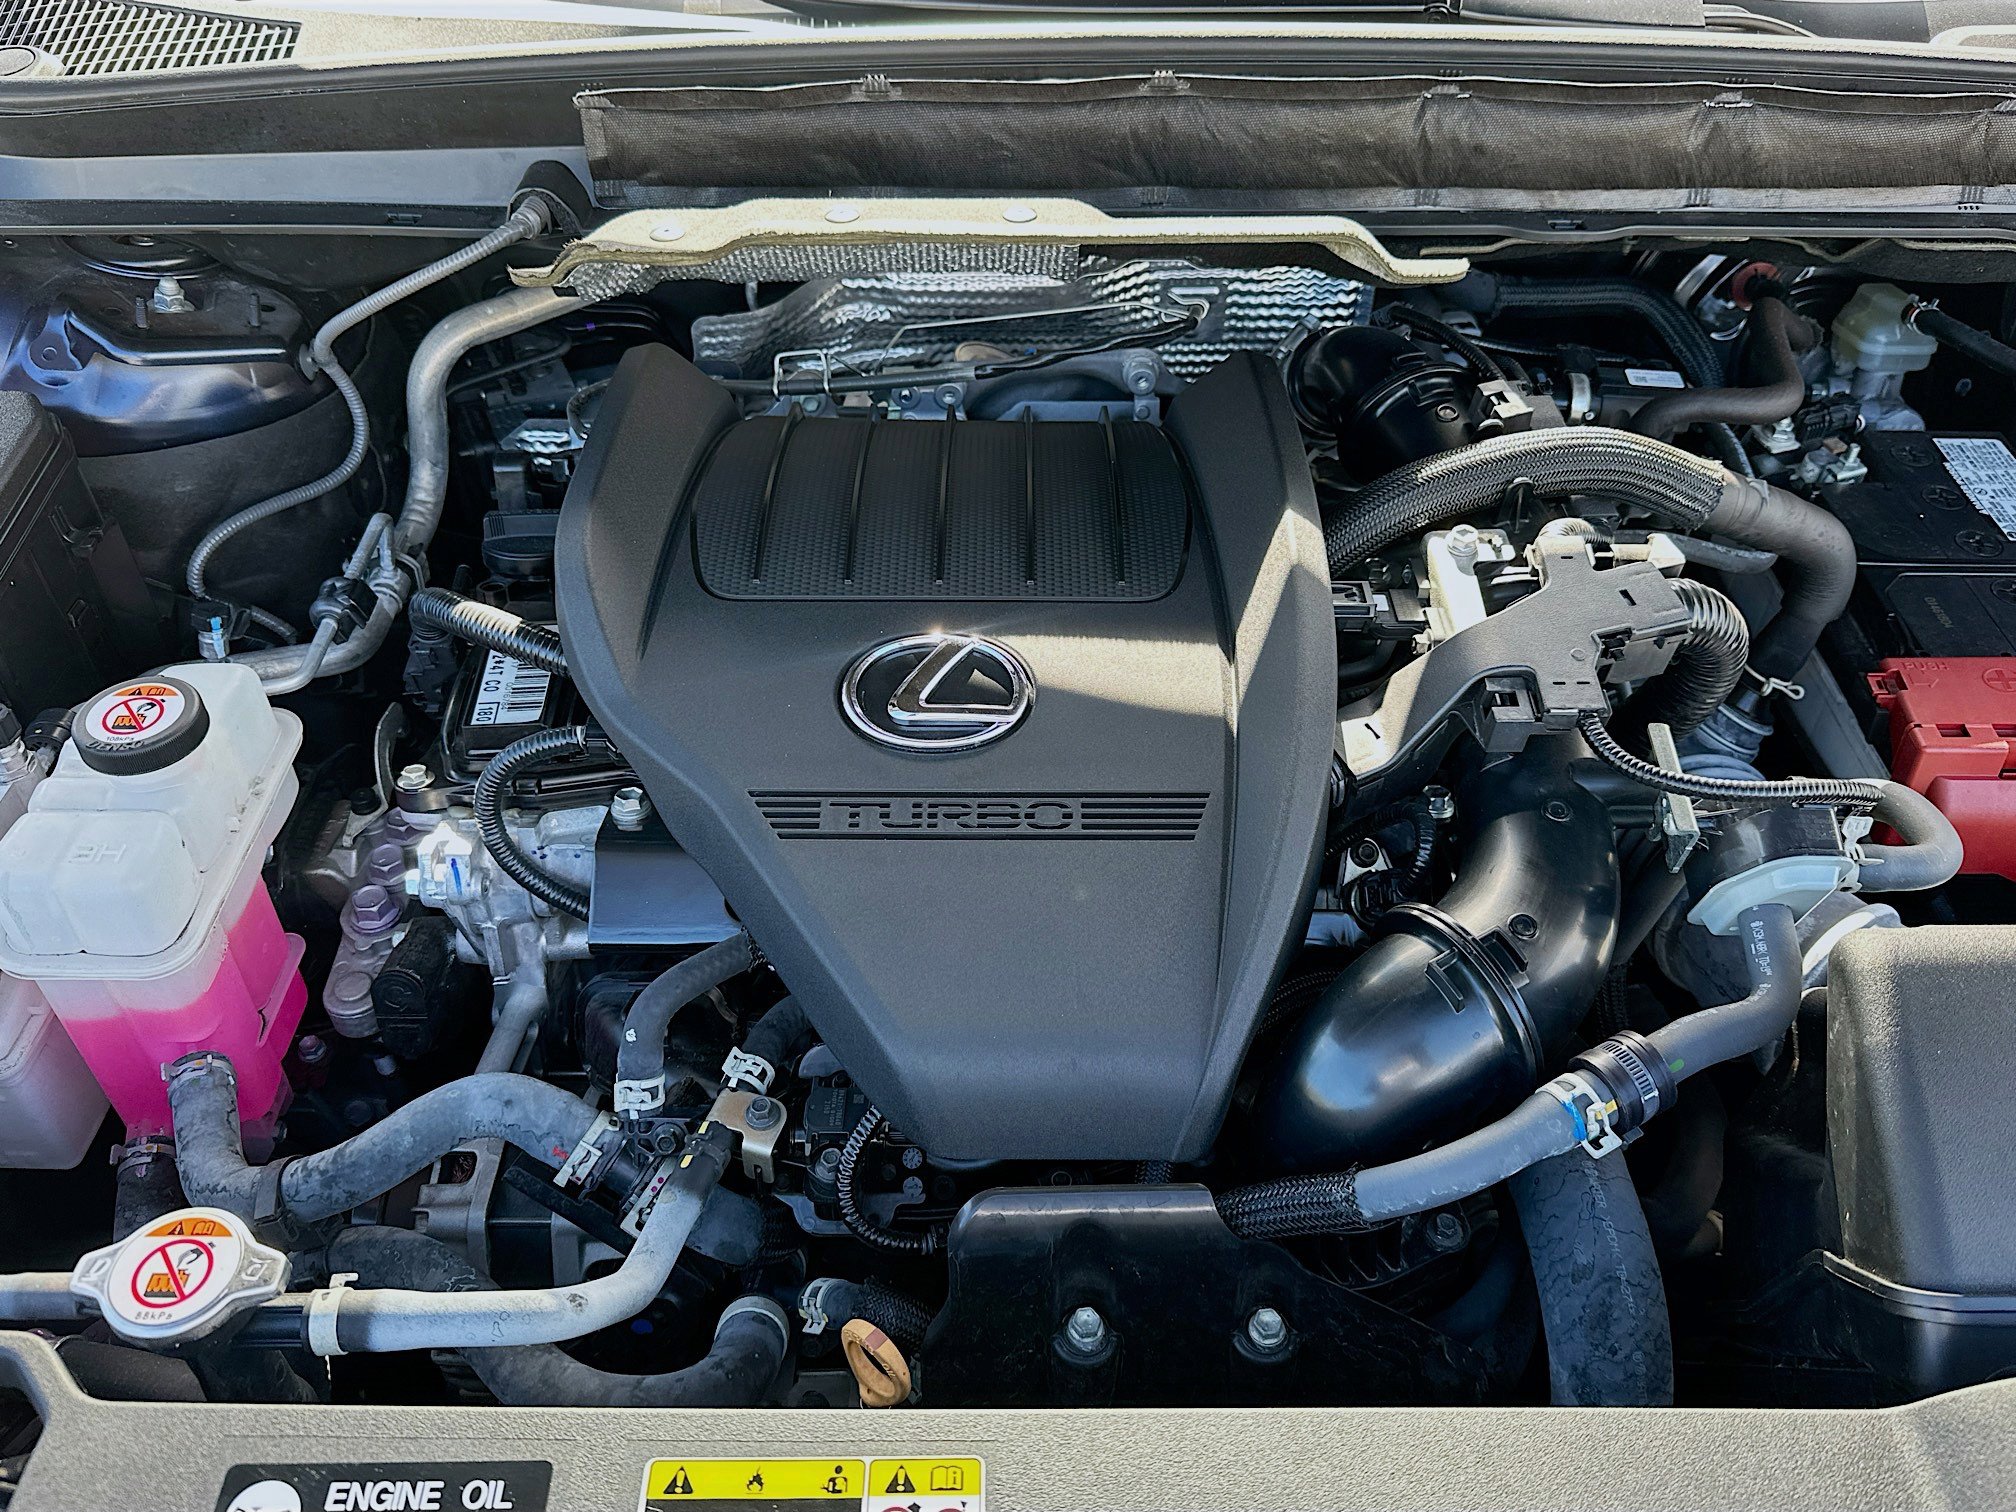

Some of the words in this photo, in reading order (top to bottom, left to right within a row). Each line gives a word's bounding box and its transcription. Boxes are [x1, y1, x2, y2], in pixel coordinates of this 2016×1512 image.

[476, 707, 494, 722] 180
[86, 740, 144, 752] DENSO
[828, 799, 1075, 830] TURBO
[134, 1311, 173, 1320] 88kPa
[323, 1480, 445, 1511] ENGINE
[461, 1479, 514, 1510] OIL
